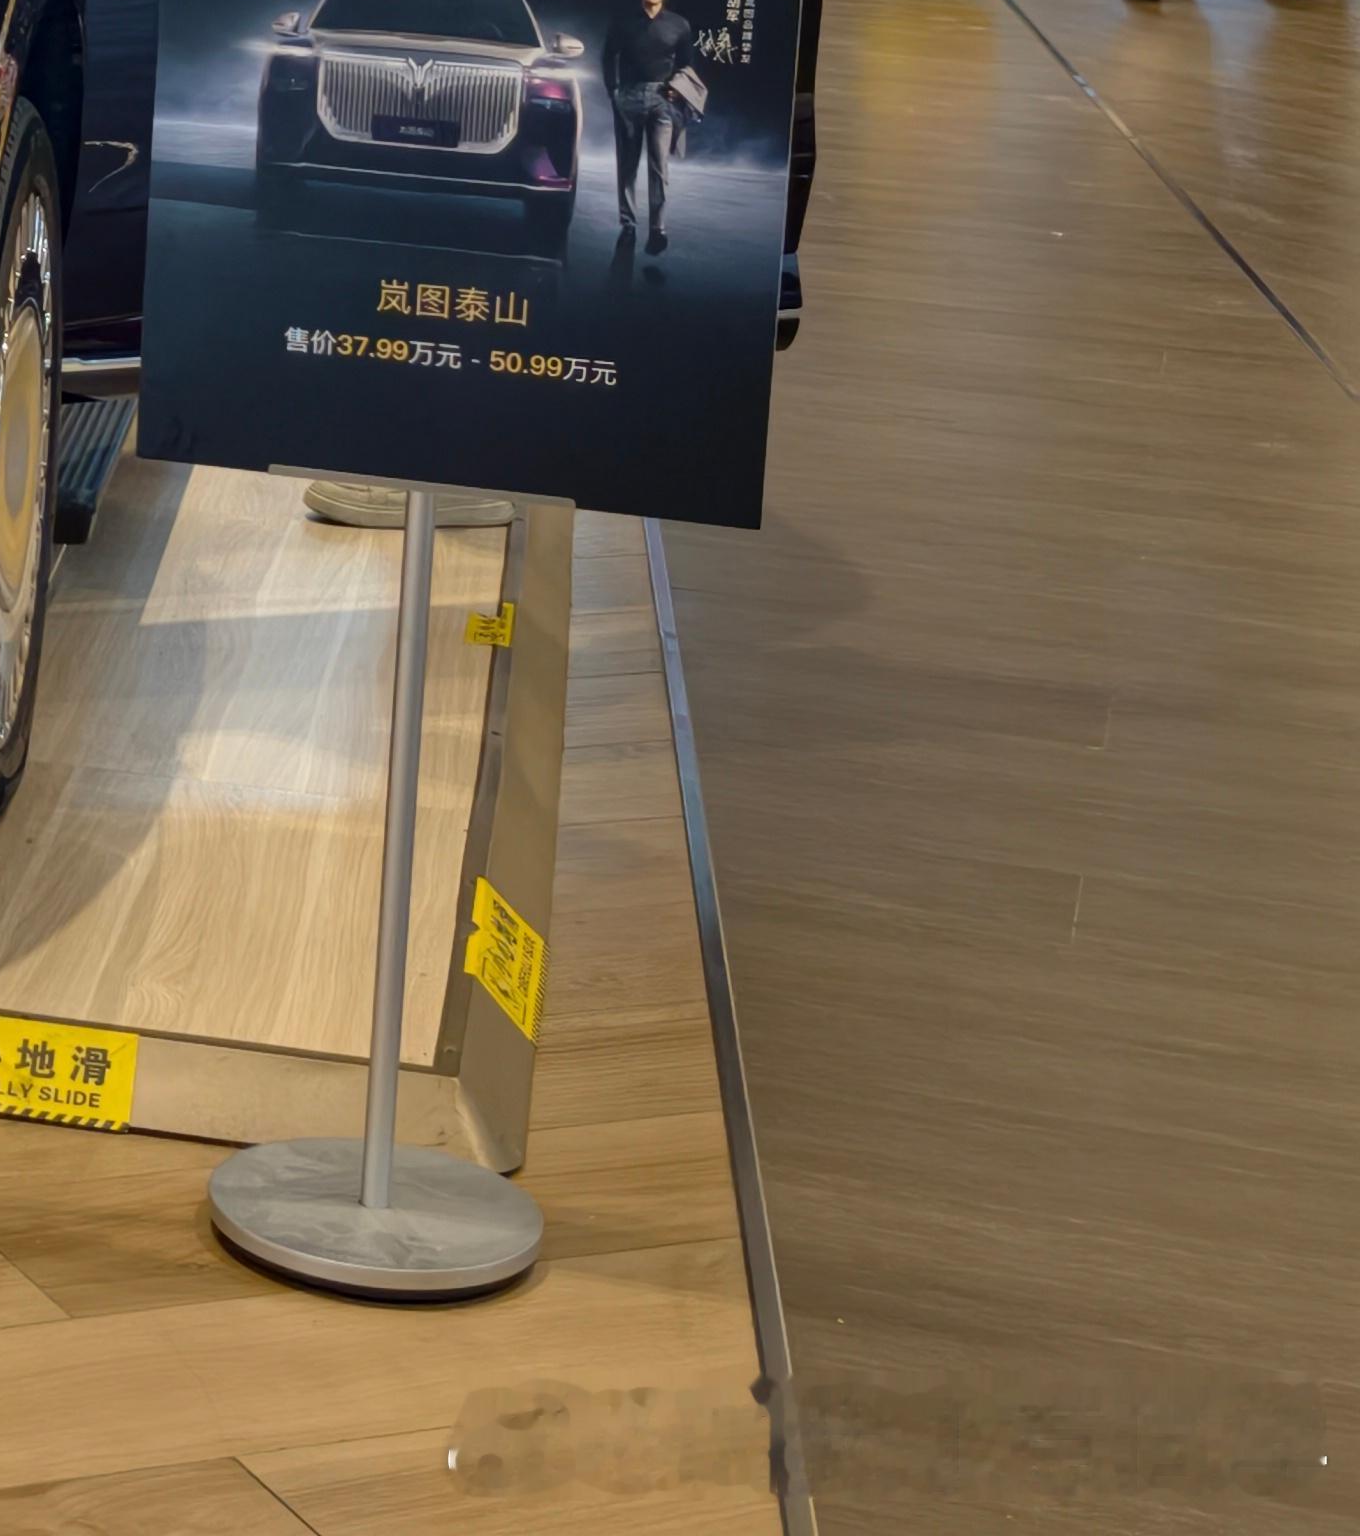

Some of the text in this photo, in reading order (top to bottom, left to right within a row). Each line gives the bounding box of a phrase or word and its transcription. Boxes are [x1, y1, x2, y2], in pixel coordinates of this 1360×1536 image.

[376, 279, 529, 328] 岚图泰山
[284, 326, 463, 370] 售价37.99万元
[489, 349, 618, 387] 50.99万元
[37, 1085, 103, 1108] SLIDE
